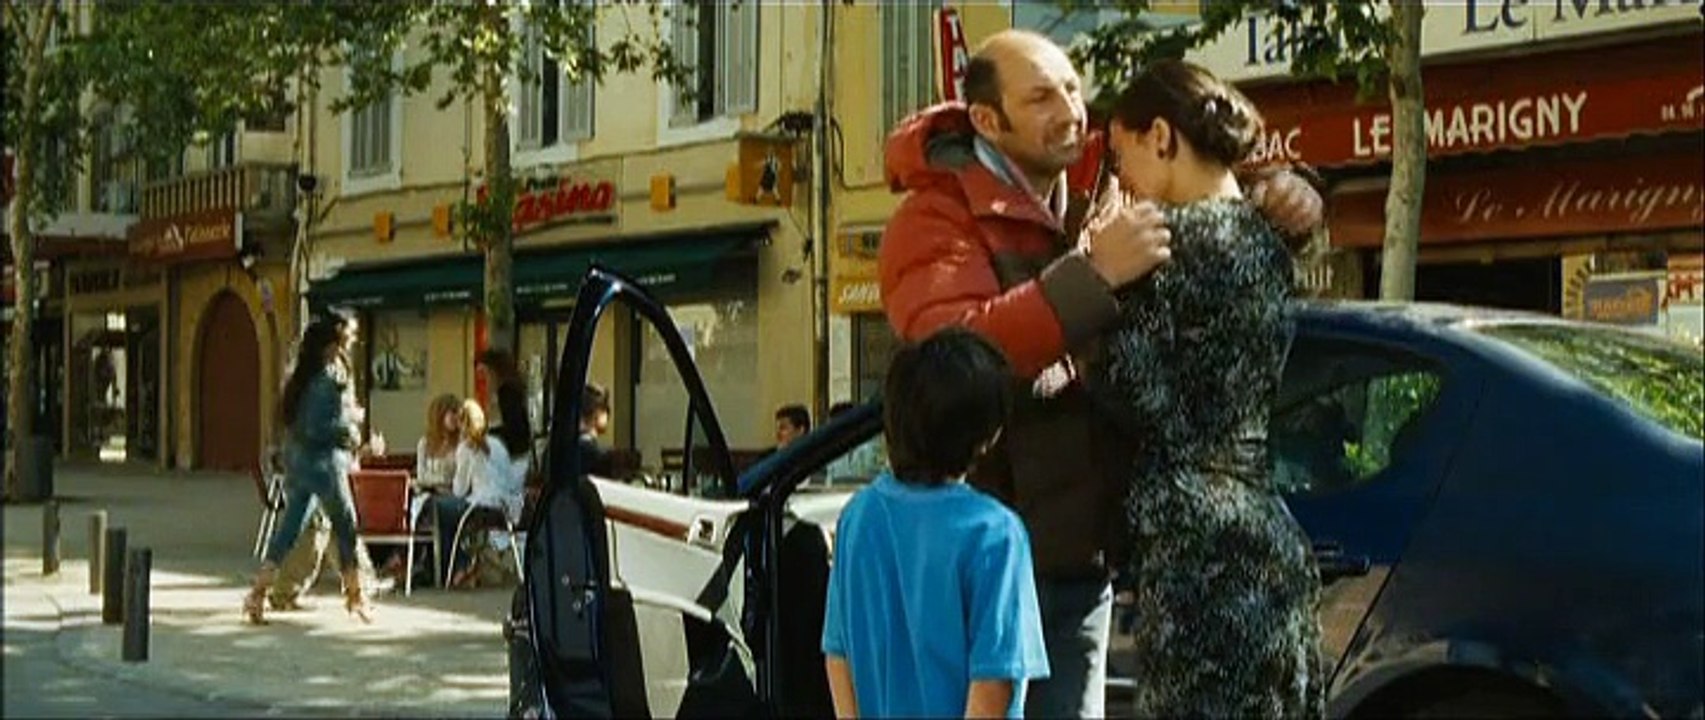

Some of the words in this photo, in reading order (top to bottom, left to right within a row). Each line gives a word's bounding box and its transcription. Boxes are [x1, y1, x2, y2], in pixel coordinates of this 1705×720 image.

[1352, 114, 1392, 157] LE
[1423, 90, 1588, 148] MARIGNY
[476, 179, 615, 232] asino
